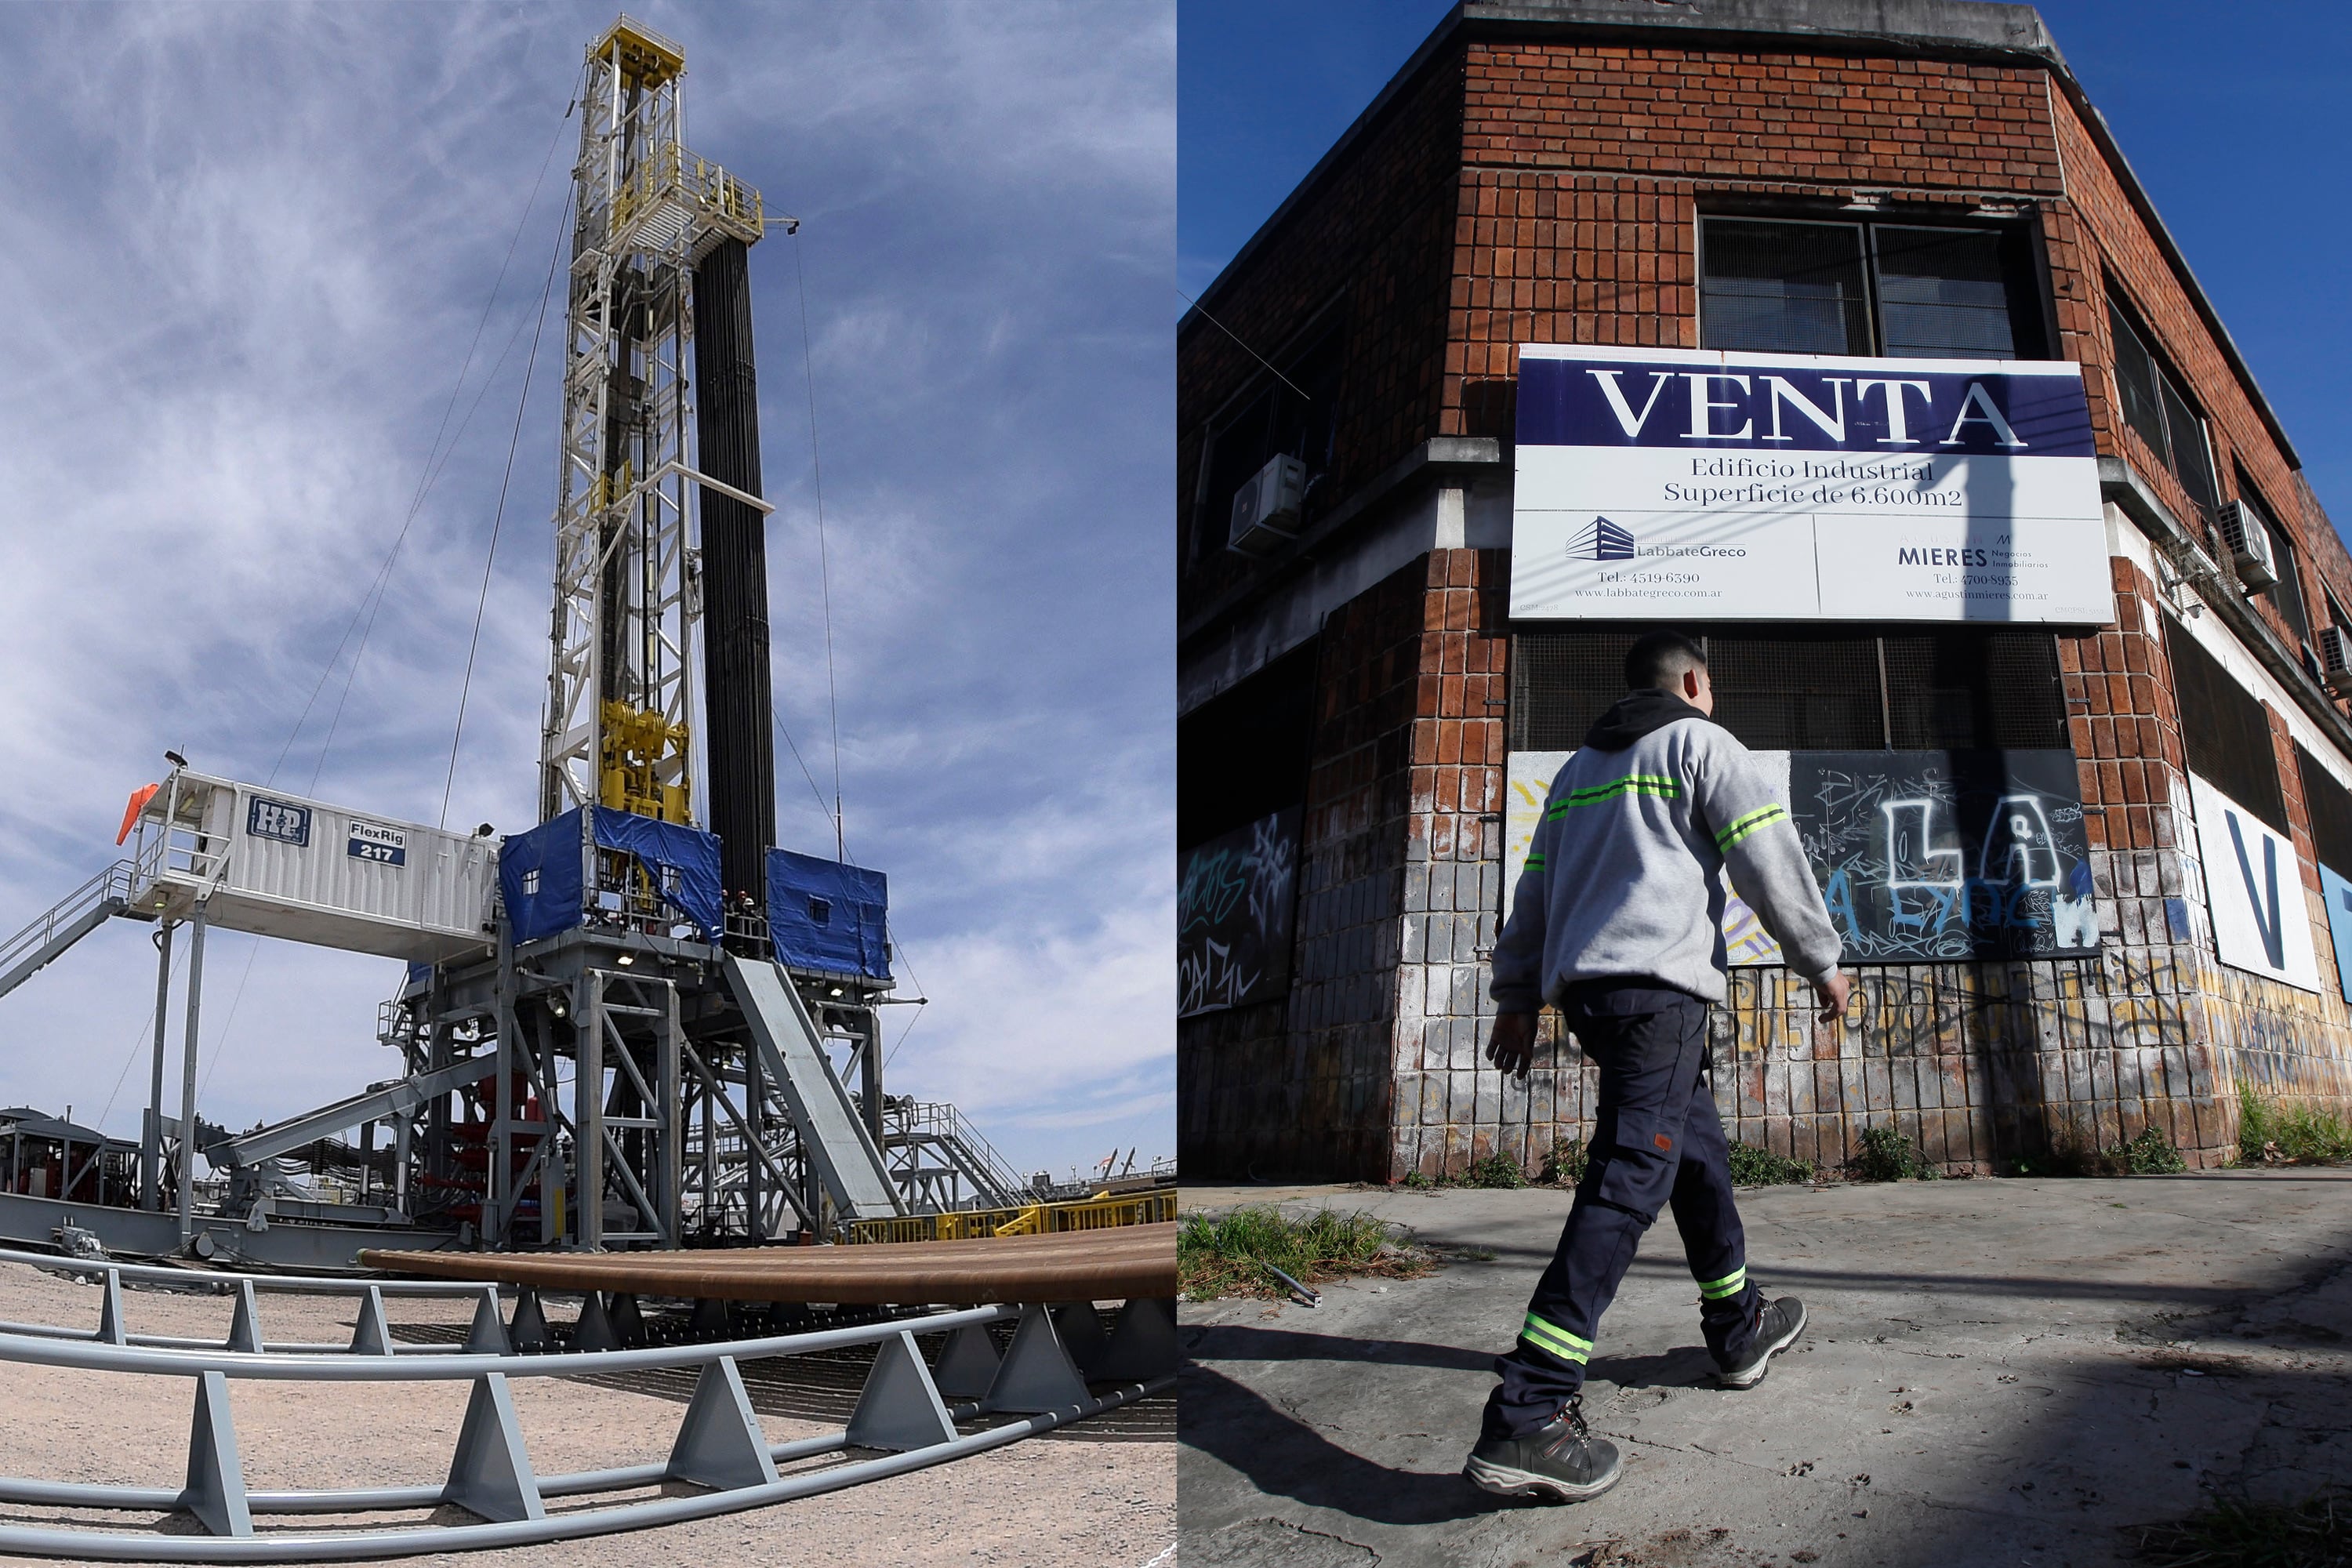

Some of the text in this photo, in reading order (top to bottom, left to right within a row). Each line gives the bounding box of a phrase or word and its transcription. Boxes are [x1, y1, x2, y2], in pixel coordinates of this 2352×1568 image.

[1585, 369, 2029, 447] VENTA
[1690, 457, 1935, 481] Edificio Industrial
[1664, 483, 1963, 507] Superficie de 6.600m2
[1637, 545, 1747, 557] LabbateGreco
[1898, 546, 1988, 568] MIERES
[1991, 550, 2032, 558] Negocios
[1991, 560, 2049, 569] Inmobiliarios
[1597, 572, 1700, 583] Tel.: 4519-6390
[1933, 573, 2019, 586] Tel.: 4700-8935
[1574, 588, 1723, 599] www.labbategreco.com.ar
[1905, 590, 2049, 601] www.agustinmieres.com.ar
[351, 824, 404, 845] FlexRig
[360, 845, 394, 861] 217
